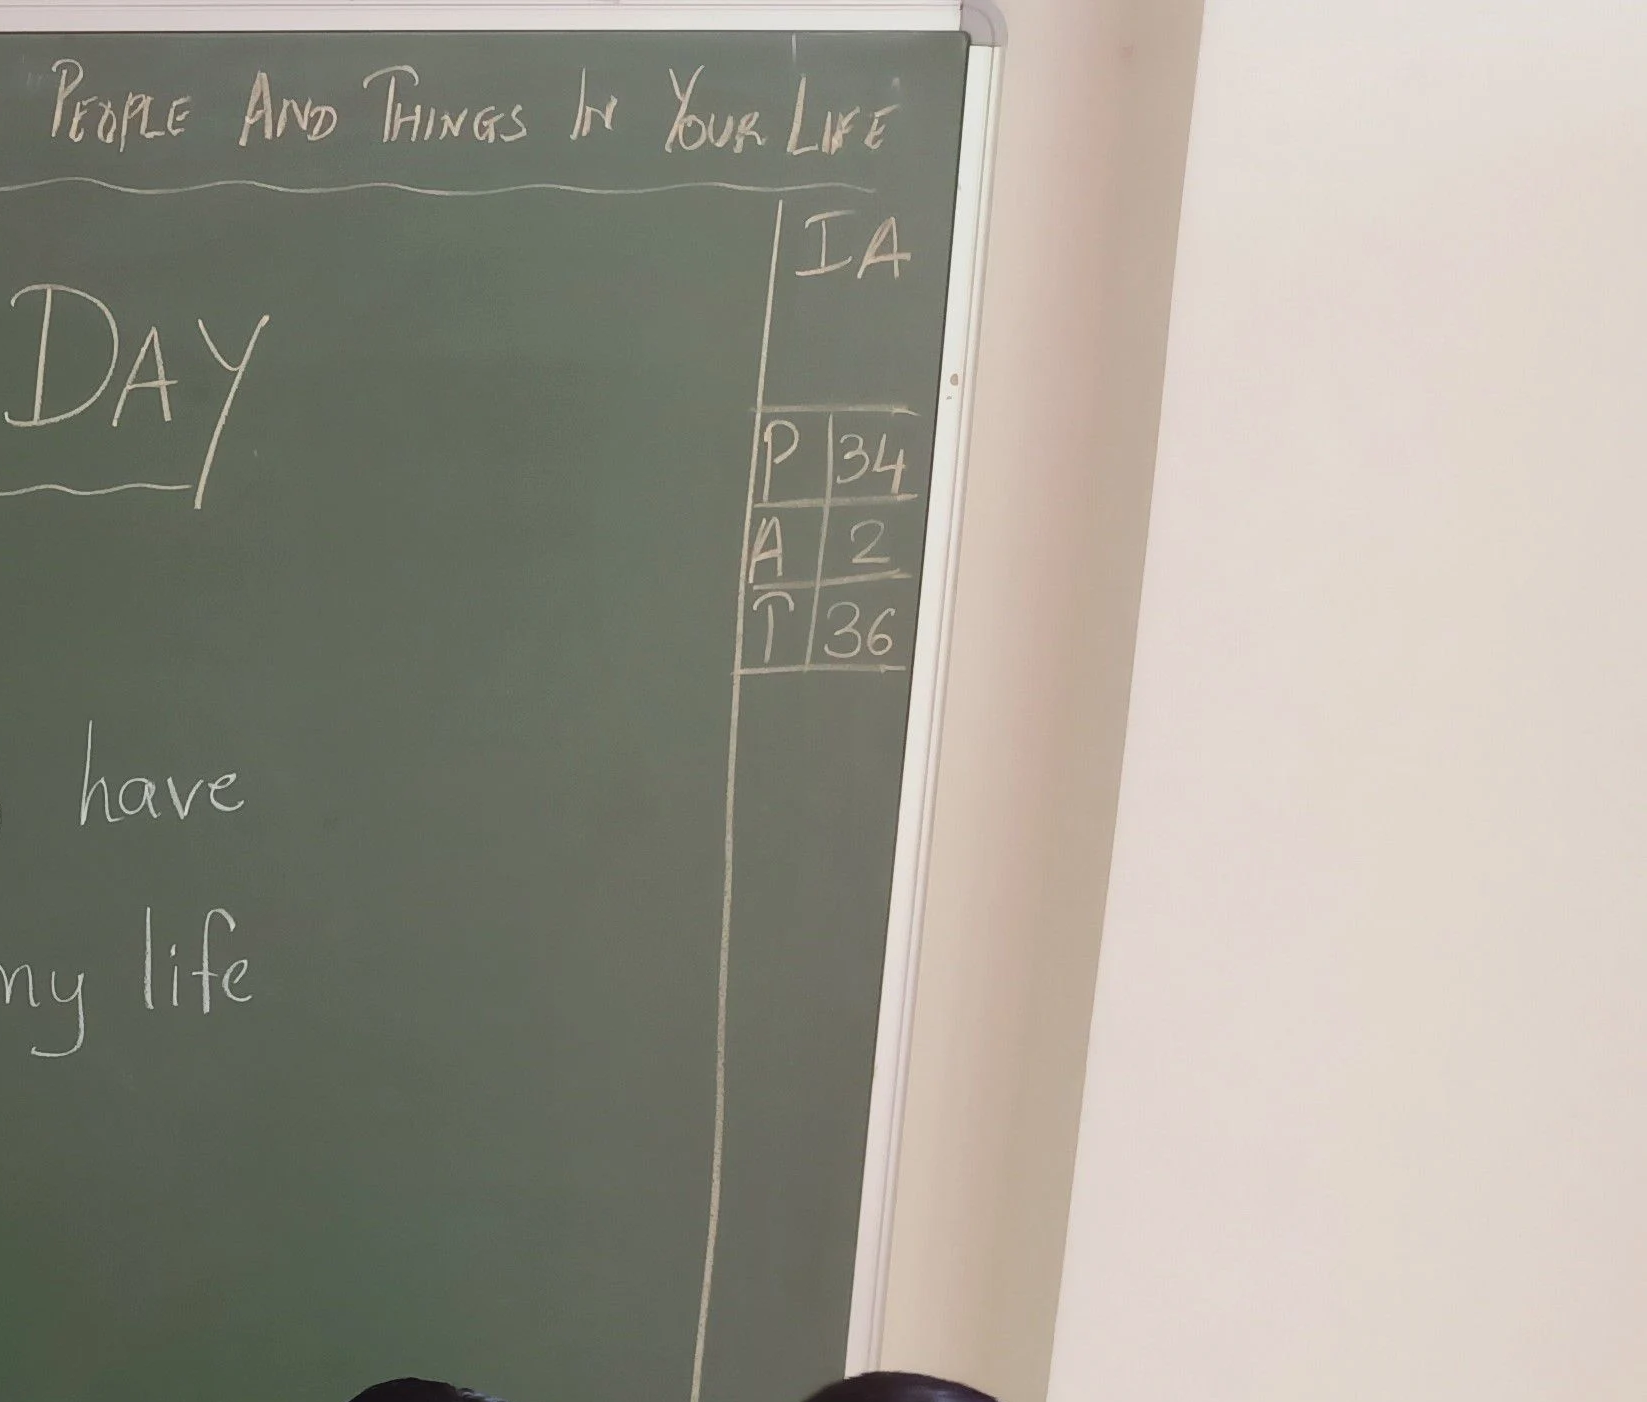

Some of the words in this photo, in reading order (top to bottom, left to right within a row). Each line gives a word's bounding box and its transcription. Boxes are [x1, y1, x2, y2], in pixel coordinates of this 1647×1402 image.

[51, 57, 192, 153] PEOPLE
[238, 70, 338, 146] AND
[362, 64, 528, 147] THINGS
[568, 67, 618, 141] IN
[666, 65, 768, 154] YOUR
[786, 74, 902, 155] LIFE
[3, 283, 270, 510] DAY
[762, 418, 800, 503] P
[836, 432, 907, 495] 34
[748, 515, 784, 584] A
[850, 519, 891, 564] 2
[752, 590, 795, 664] T
[823, 601, 897, 659] 36
[79, 719, 246, 827] have
[143, 905, 254, 1015] life
